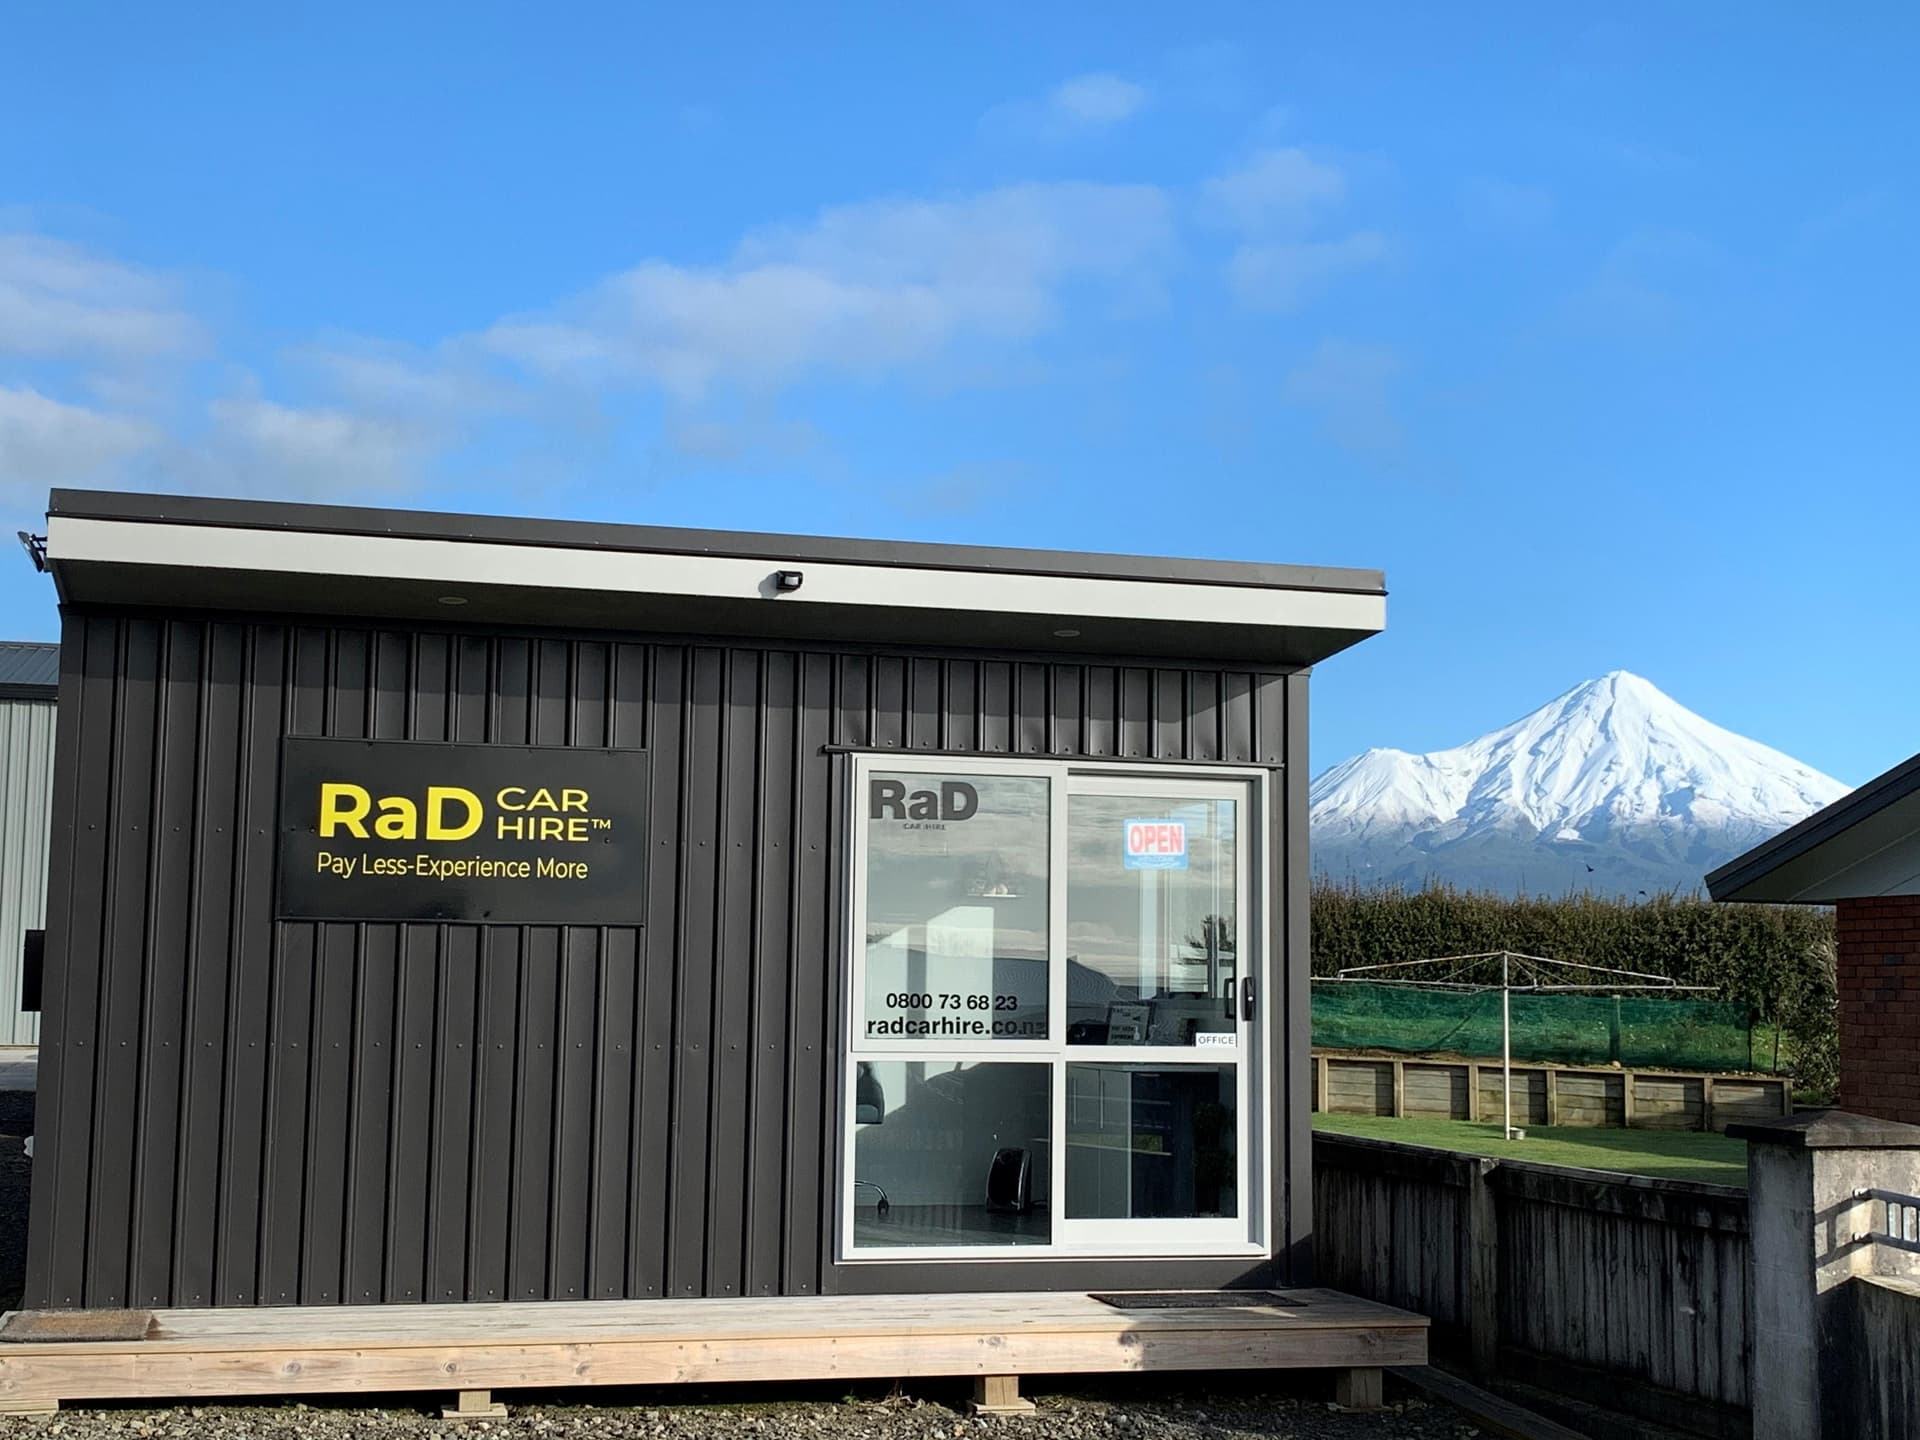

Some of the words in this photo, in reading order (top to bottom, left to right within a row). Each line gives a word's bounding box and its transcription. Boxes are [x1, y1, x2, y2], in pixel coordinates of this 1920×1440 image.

[319, 783, 483, 840] RaD
[496, 787, 589, 812] CAR
[869, 780, 978, 820] RaD
[1130, 825, 1182, 853] OPEN
[317, 852, 357, 879] Pay
[536, 857, 588, 879] More
[886, 993, 933, 1009] 0800
[938, 994, 962, 1010] 73
[966, 995, 990, 1010] 68
[994, 995, 1018, 1011] 23
[1198, 1036, 1234, 1045] OFFICE
